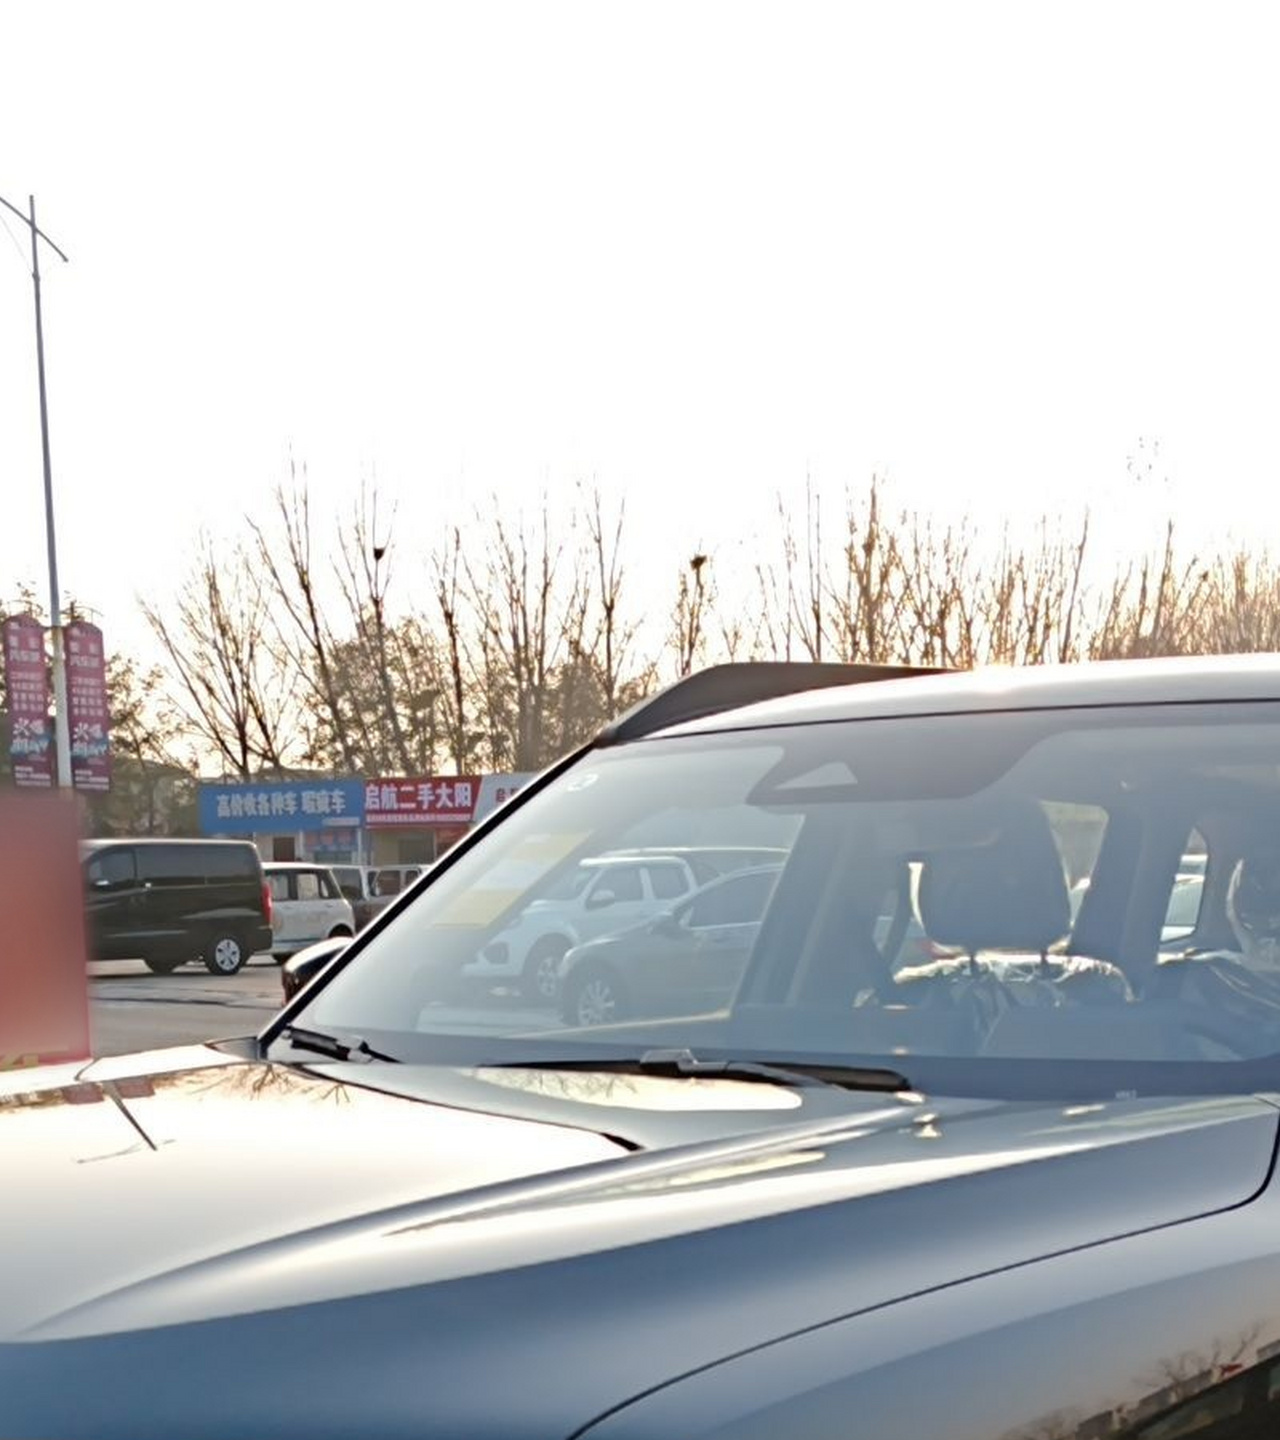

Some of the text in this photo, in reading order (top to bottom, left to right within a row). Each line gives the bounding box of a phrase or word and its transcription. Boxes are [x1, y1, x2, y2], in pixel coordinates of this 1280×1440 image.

[365, 782, 472, 810] 启航二手大阳
